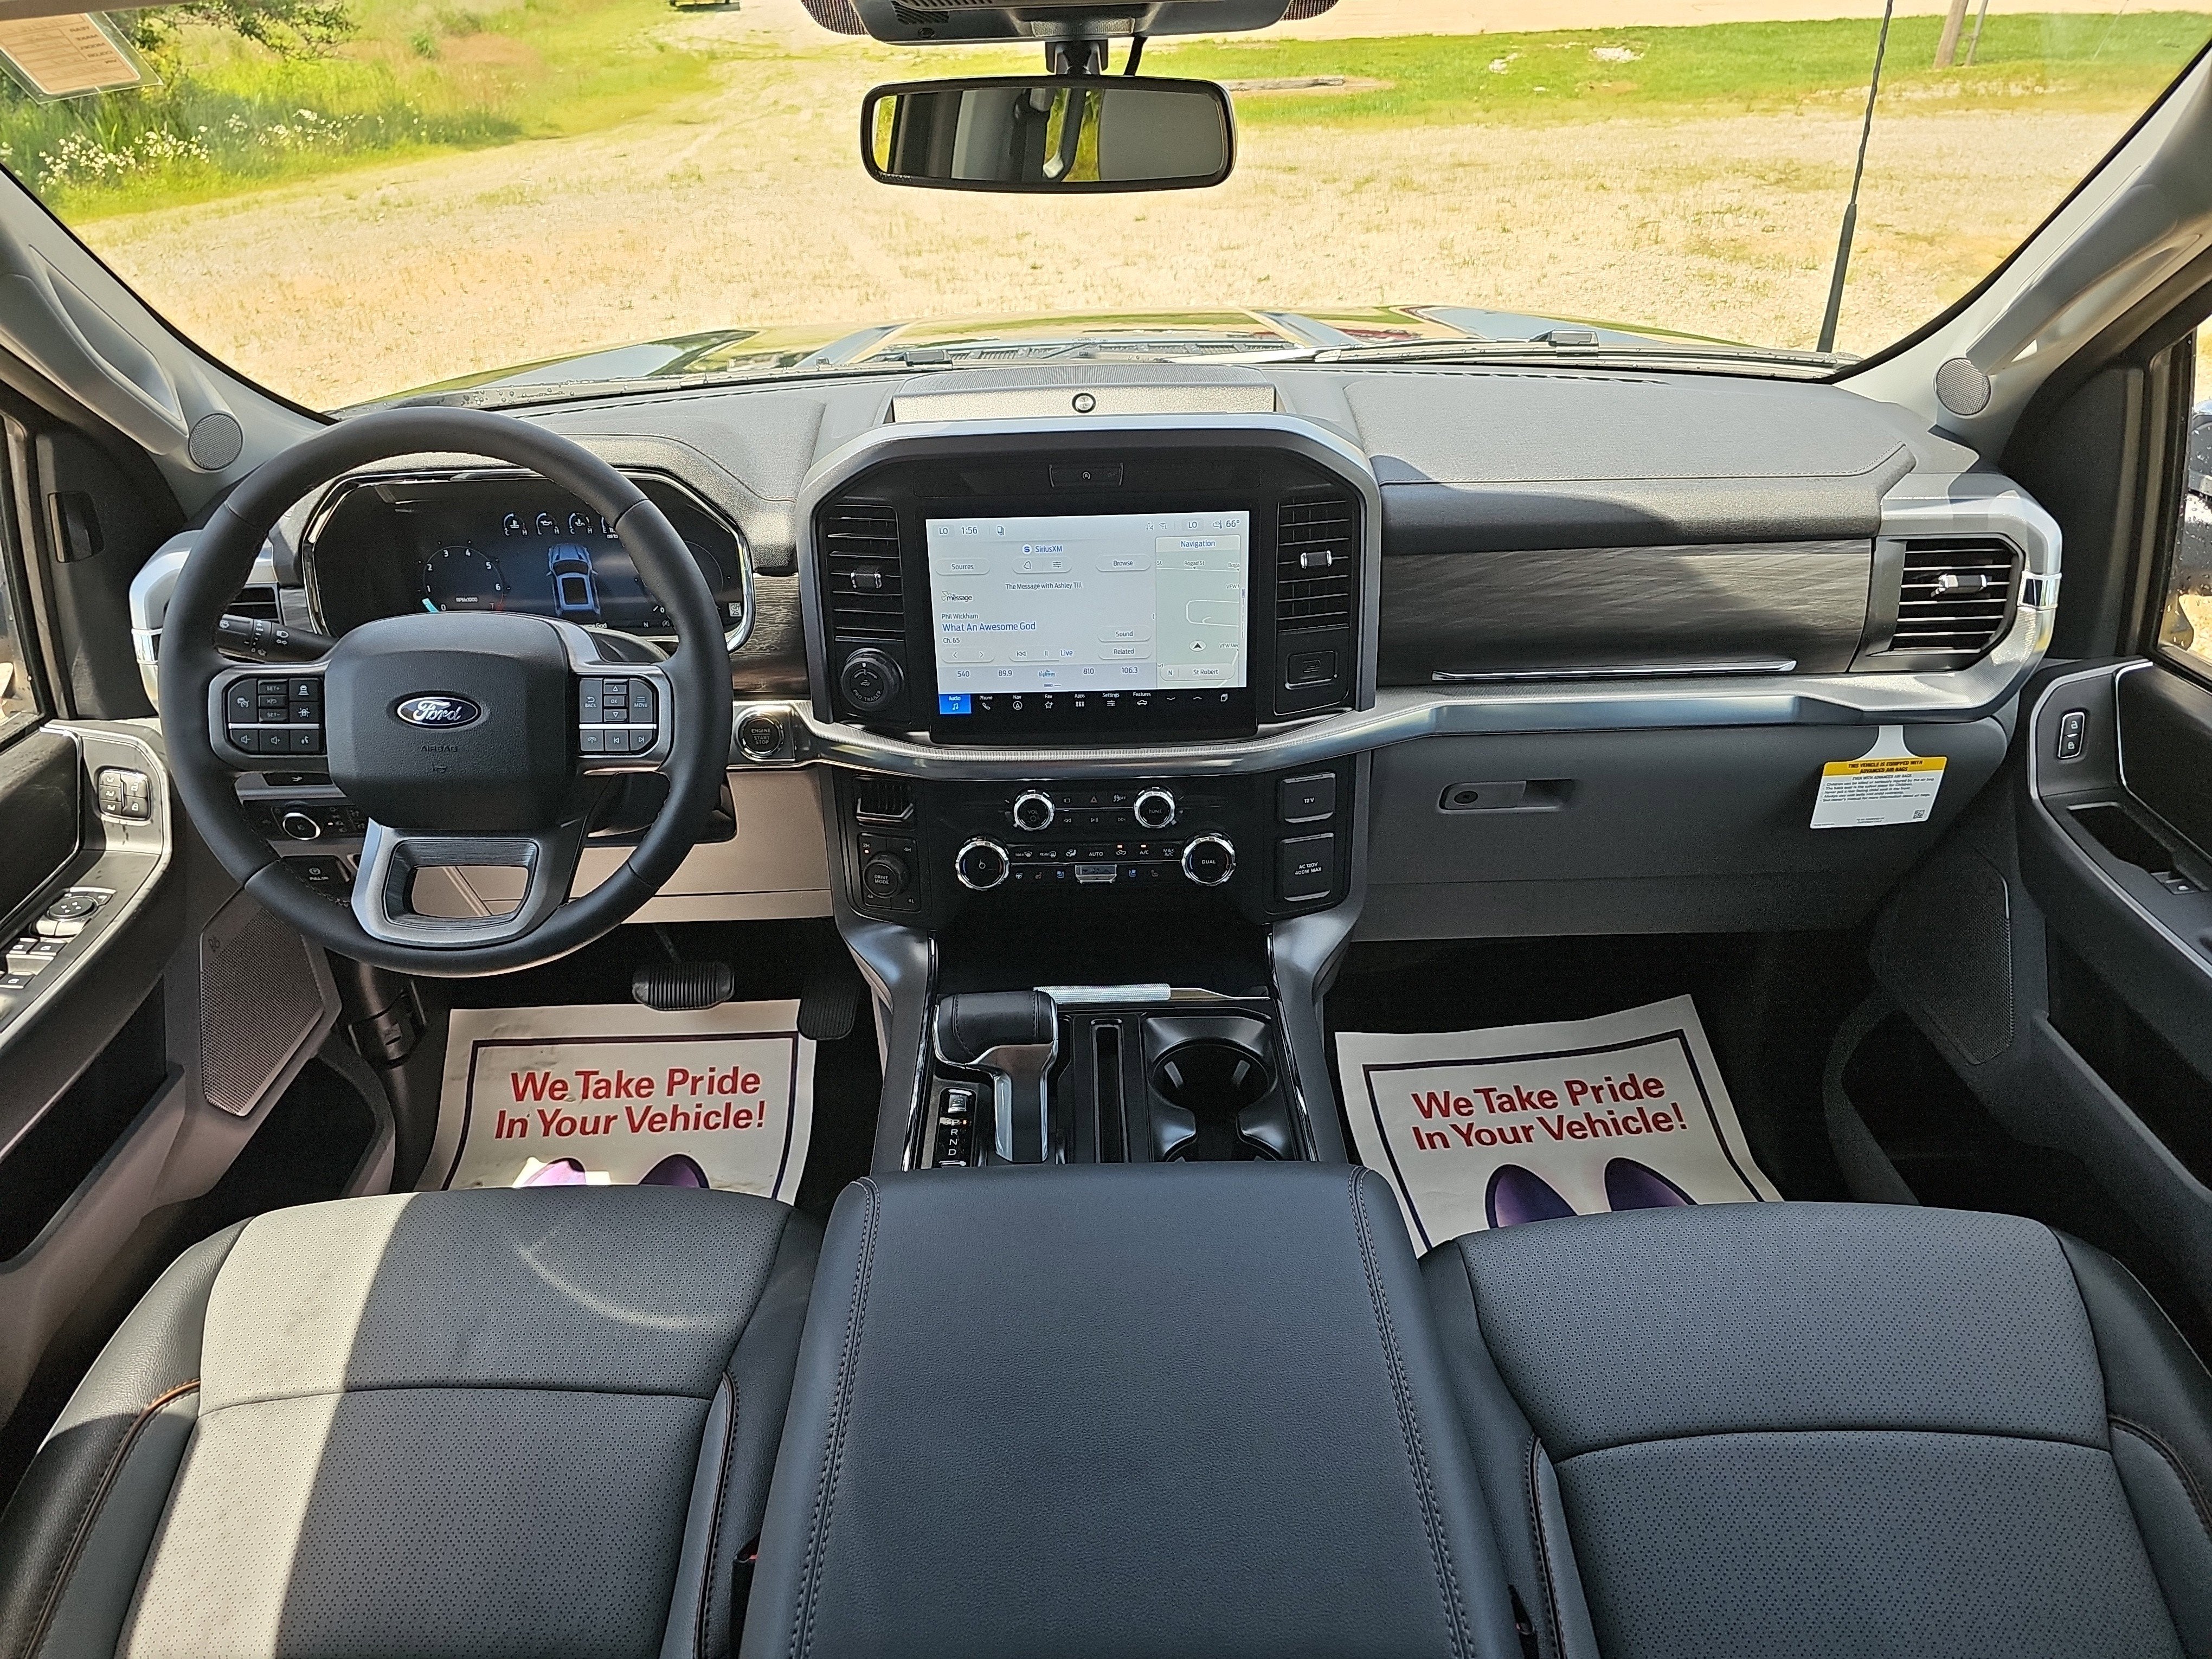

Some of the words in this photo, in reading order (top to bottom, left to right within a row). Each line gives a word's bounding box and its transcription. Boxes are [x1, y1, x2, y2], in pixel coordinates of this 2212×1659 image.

[1020, 622, 1036, 630] God
[413, 700, 462, 721] Ford
[852, 690, 863, 699] PRO
[864, 690, 882, 702] TRAILER
[511, 1071, 569, 1103] We
[575, 1069, 655, 1100] Take
[666, 1066, 761, 1097] Pride
[1411, 1090, 1474, 1120] We
[1474, 1085, 1558, 1114] Take
[1564, 1073, 1666, 1107] Pride
[494, 1110, 528, 1139] In
[538, 1108, 618, 1137] Your
[625, 1100, 766, 1134] Vehicle!
[1412, 1126, 1451, 1150] In
[1451, 1122, 1535, 1147] Your
[1536, 1102, 1688, 1142] Vehicle!
